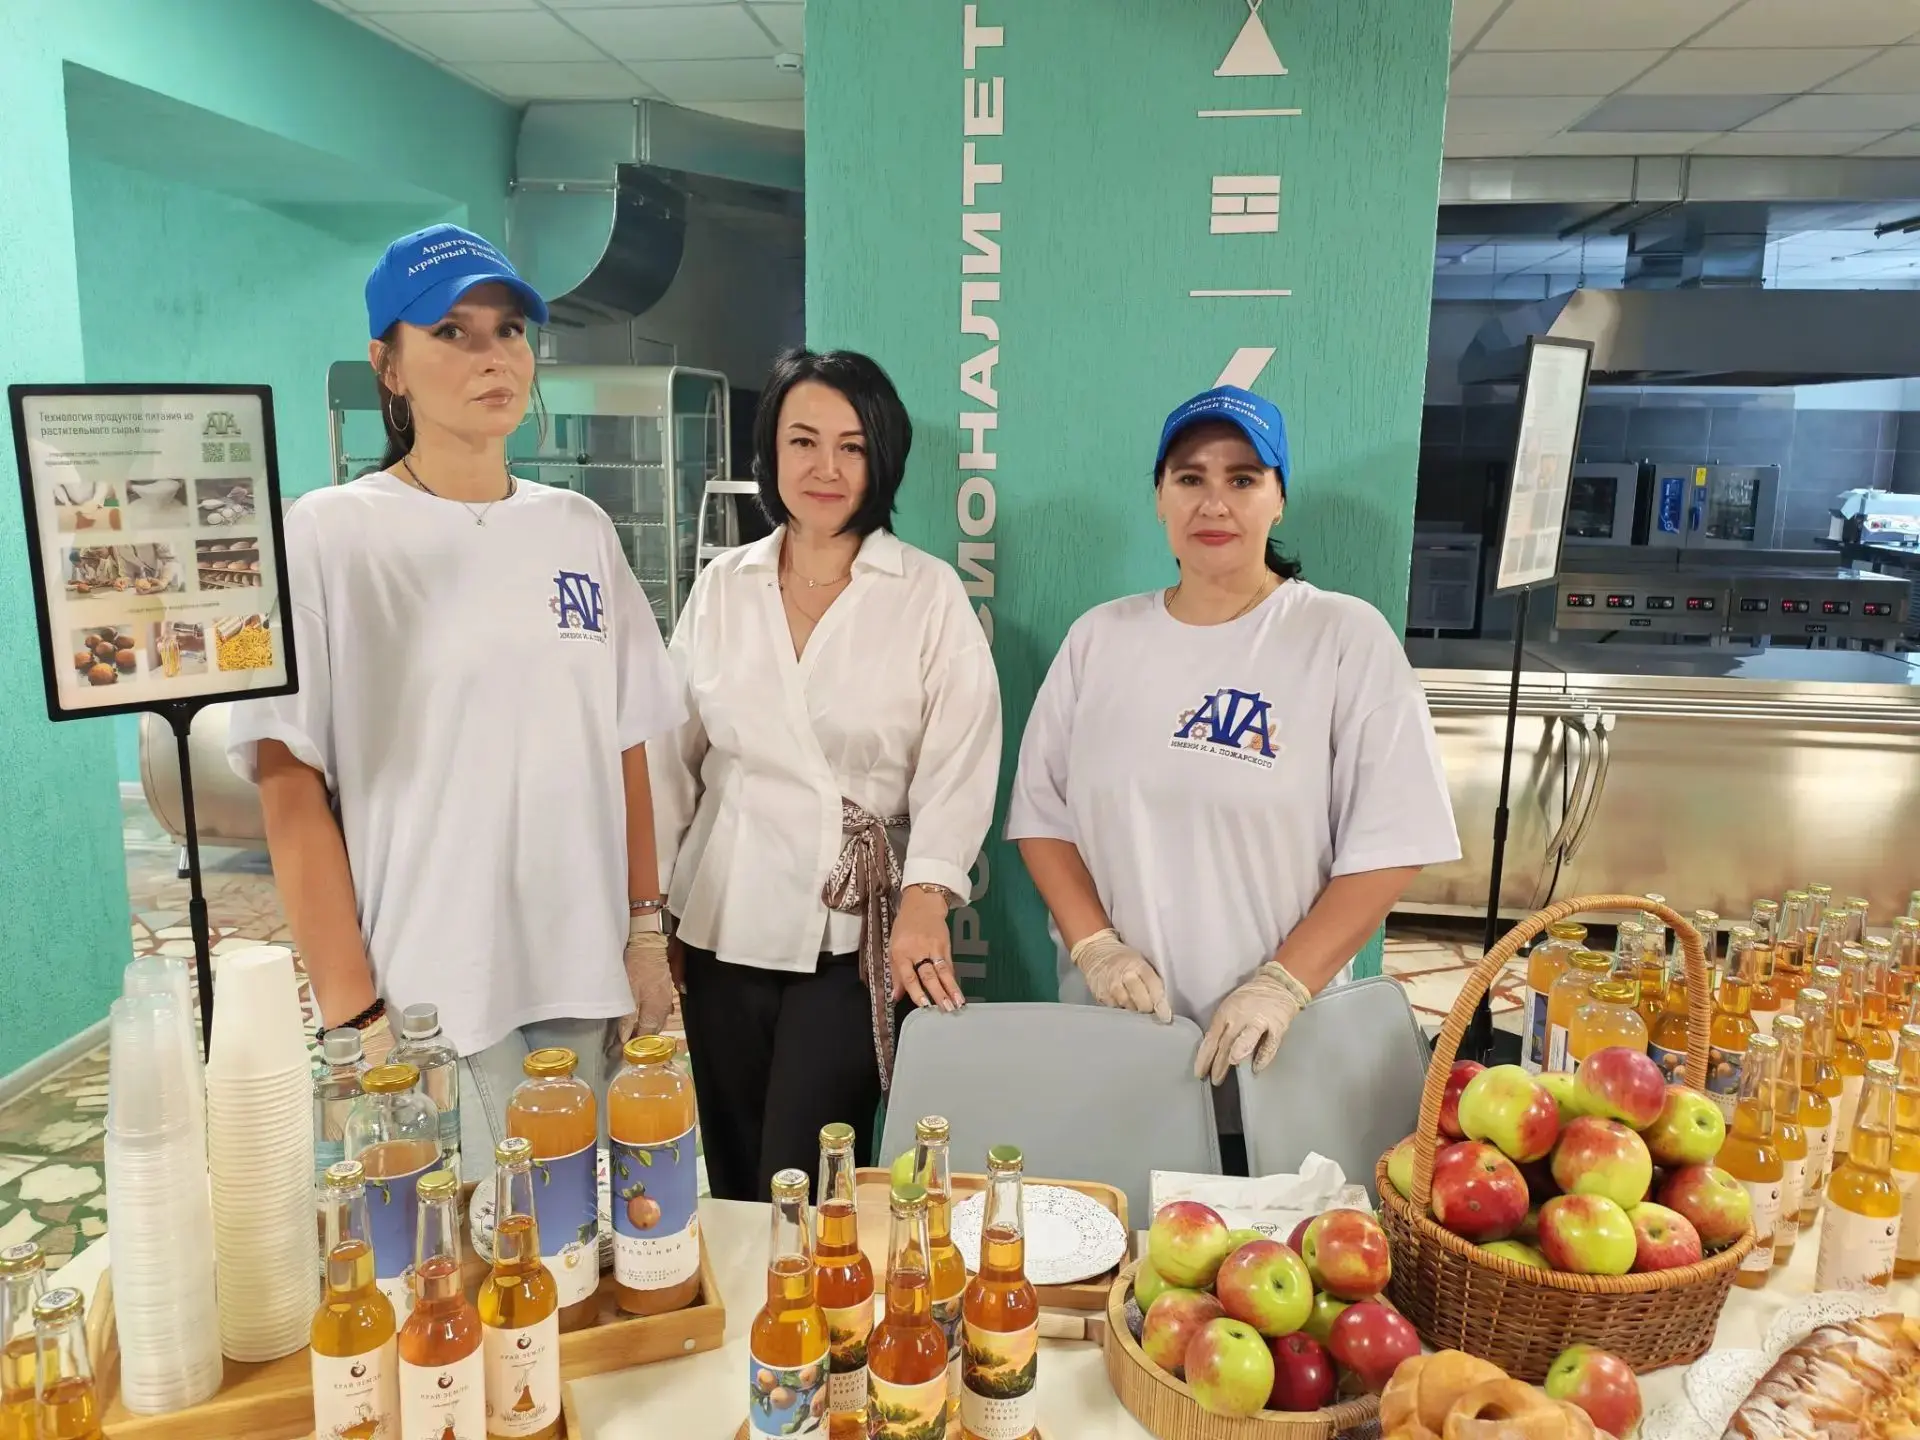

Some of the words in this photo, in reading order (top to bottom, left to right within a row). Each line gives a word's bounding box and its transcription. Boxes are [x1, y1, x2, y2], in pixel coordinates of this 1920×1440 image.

[407, 247, 468, 277] Аграрный
[39, 411, 93, 422] Технология
[94, 412, 143, 425] продуктов
[145, 411, 182, 421] питания
[1222, 402, 1270, 431] Техникум
[41, 426, 110, 439] растительного
[111, 427, 140, 438] сырья
[952, 5, 1004, 1002] ПРОИОНАЛИТЕТ
[1170, 740, 1199, 750] ИМЕНИ
[1219, 748, 1273, 769] ПОЖАРСКОГО
